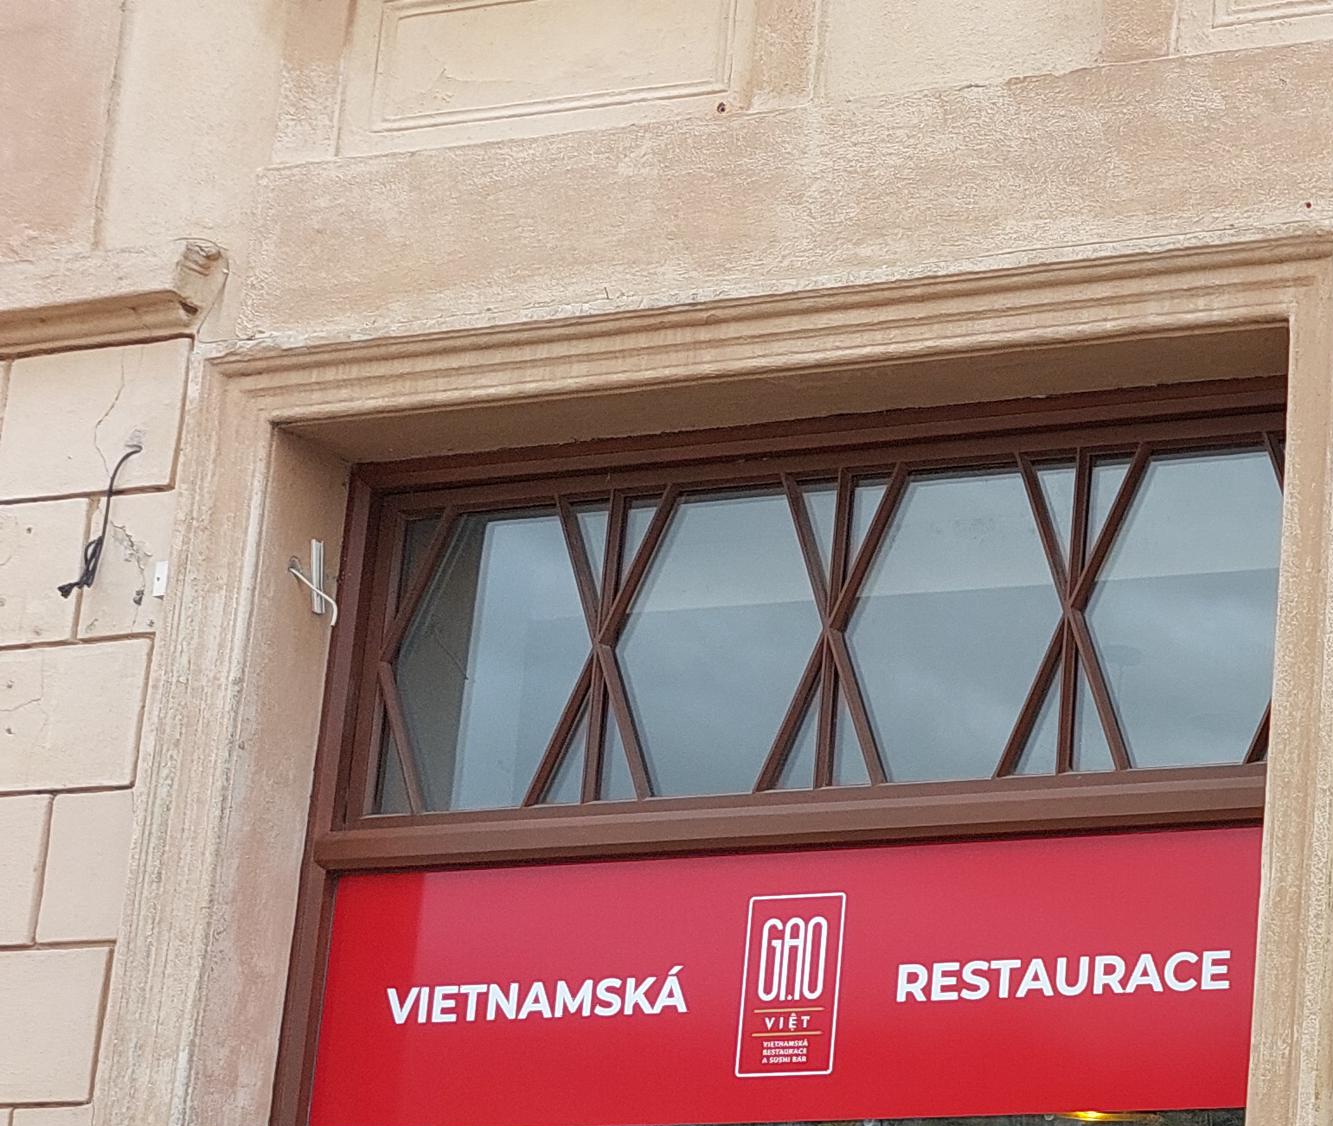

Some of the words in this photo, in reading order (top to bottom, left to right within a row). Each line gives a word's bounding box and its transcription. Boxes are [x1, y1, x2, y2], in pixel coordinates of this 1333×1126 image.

[387, 965, 688, 1025] VIETNAMSKÁ
[896, 950, 1231, 1002] RESTAURACE
[764, 1012, 811, 1031] VIỆT
[763, 1048, 808, 1056] RESTAURACE
